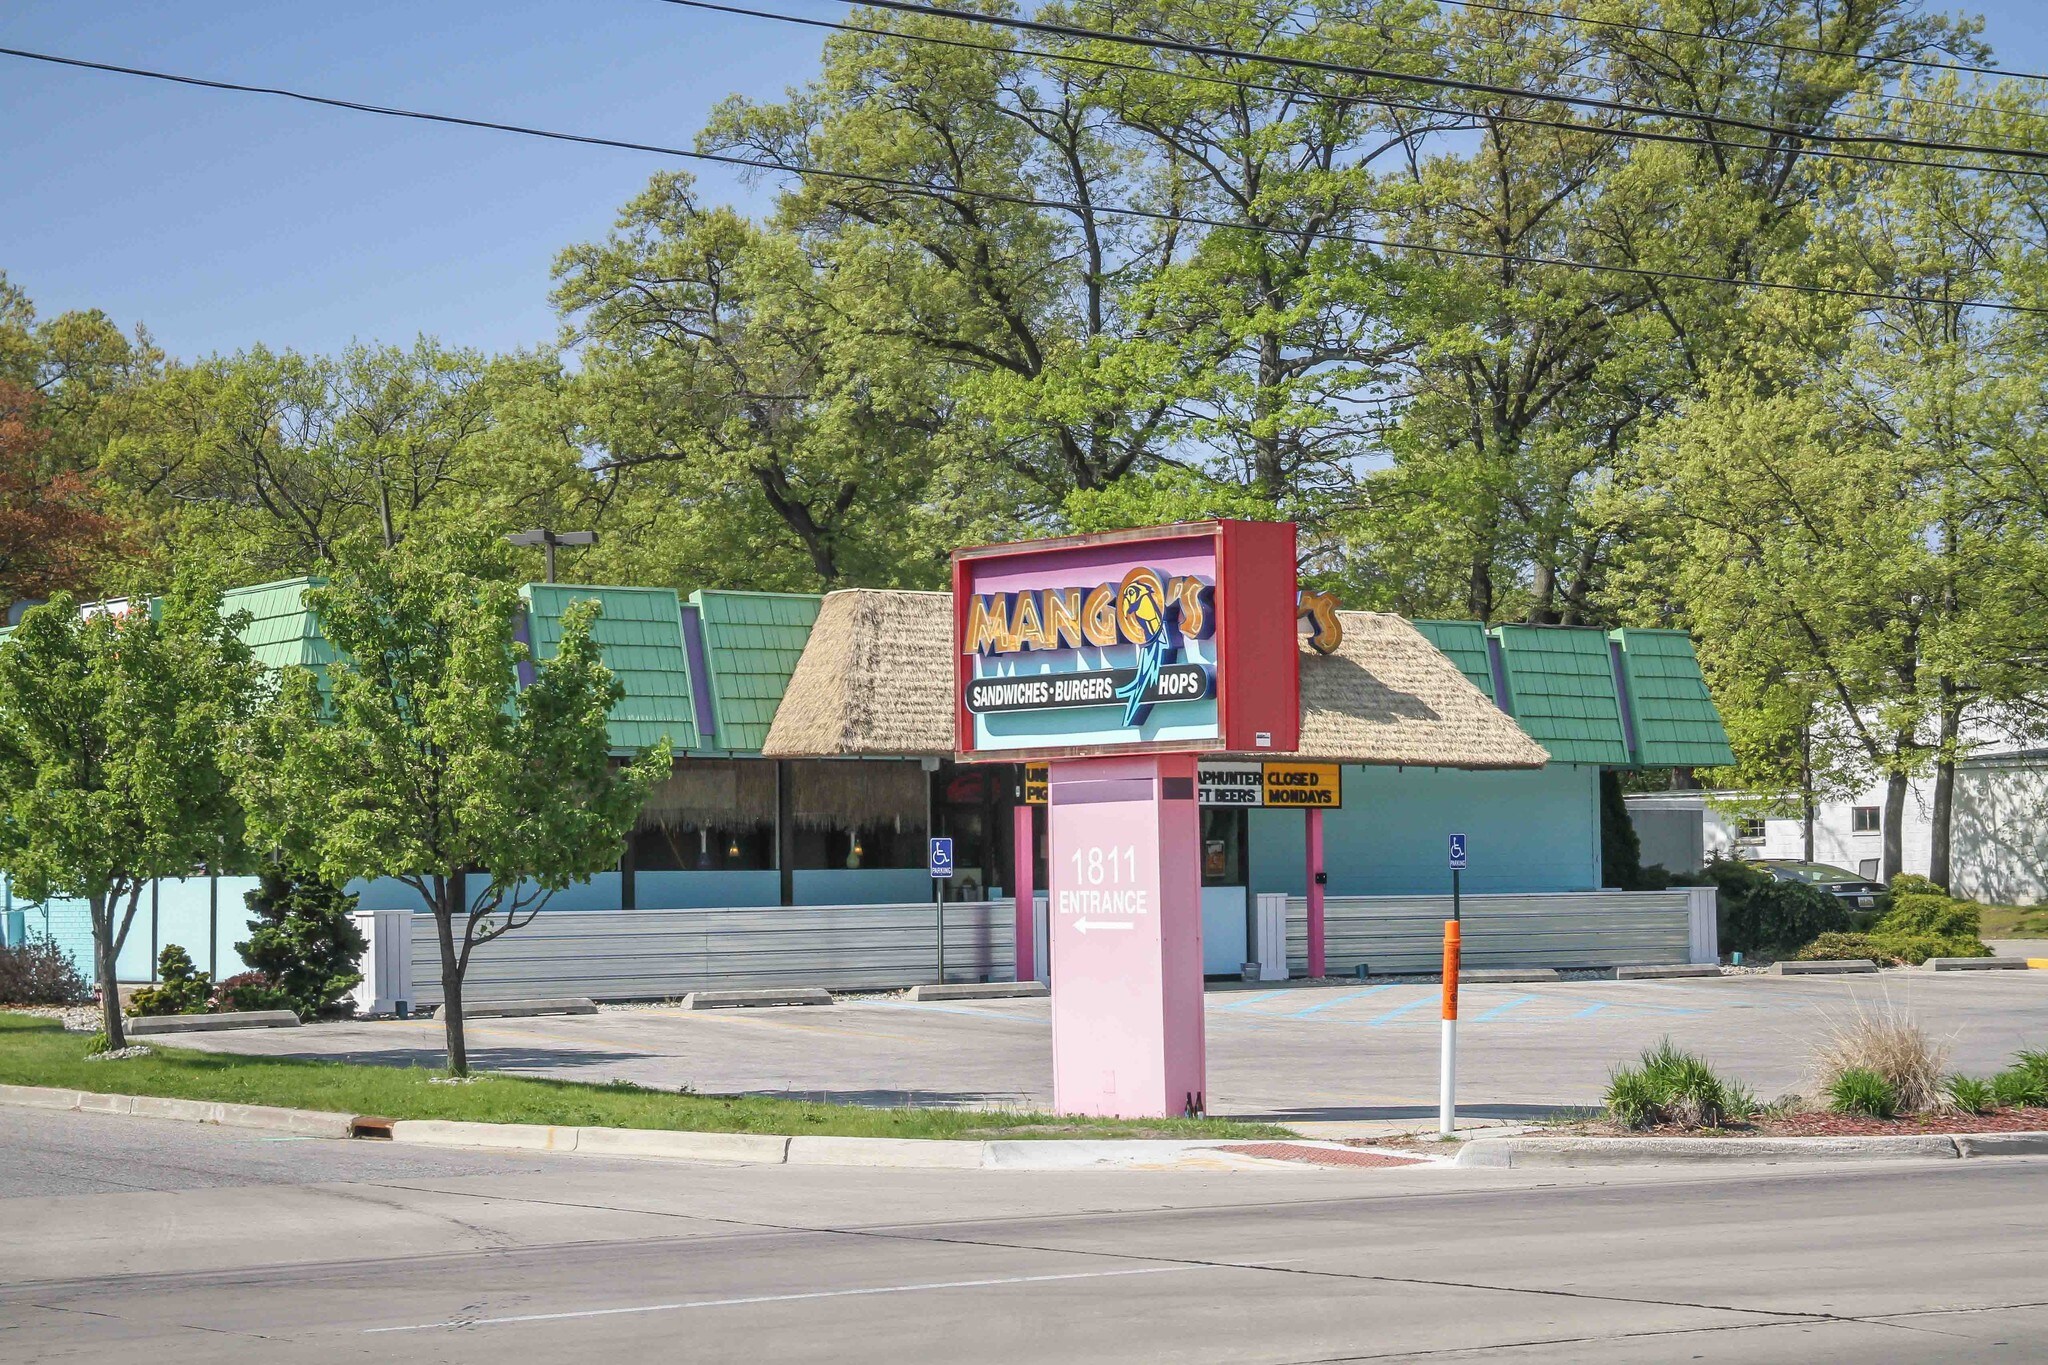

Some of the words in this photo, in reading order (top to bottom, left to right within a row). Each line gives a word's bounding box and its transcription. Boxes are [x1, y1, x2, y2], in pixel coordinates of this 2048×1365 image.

[963, 566, 1210, 655] MANGO'S
[972, 681, 1048, 707] SANDWICHES
[1054, 677, 1113, 702] BURGERS
[1158, 672, 1199, 695] HOPS
[1267, 772, 1319, 786] CLOSED
[1214, 788, 1256, 803] BEERS
[1268, 789, 1332, 804] MONDAYS
[1071, 844, 1136, 886] 1811
[1059, 890, 1148, 914] ENTRANCE
